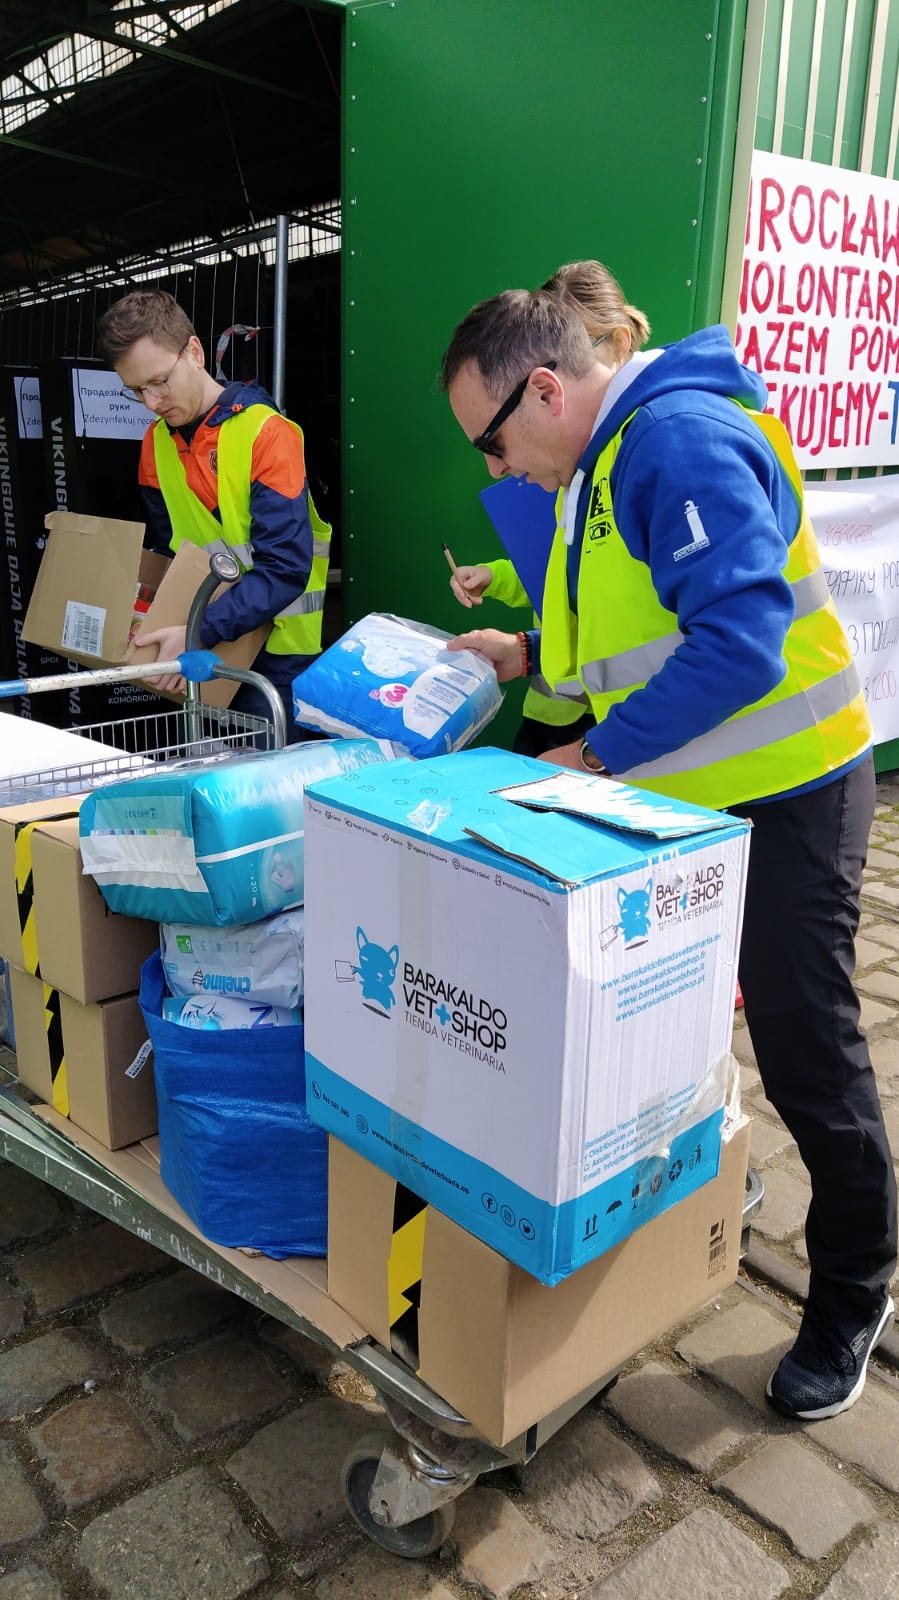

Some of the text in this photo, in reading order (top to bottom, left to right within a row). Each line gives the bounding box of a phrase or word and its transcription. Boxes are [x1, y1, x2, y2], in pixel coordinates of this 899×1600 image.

[745, 176, 899, 266] ROCŁAW
[736, 322, 829, 376] AZEM
[84, 414, 136, 427] Zdezynfekuj
[109, 402, 131, 412] руки
[403, 961, 508, 1031] BARAKALDO
[404, 1009, 507, 1075] TIENDA VETERINARIA
